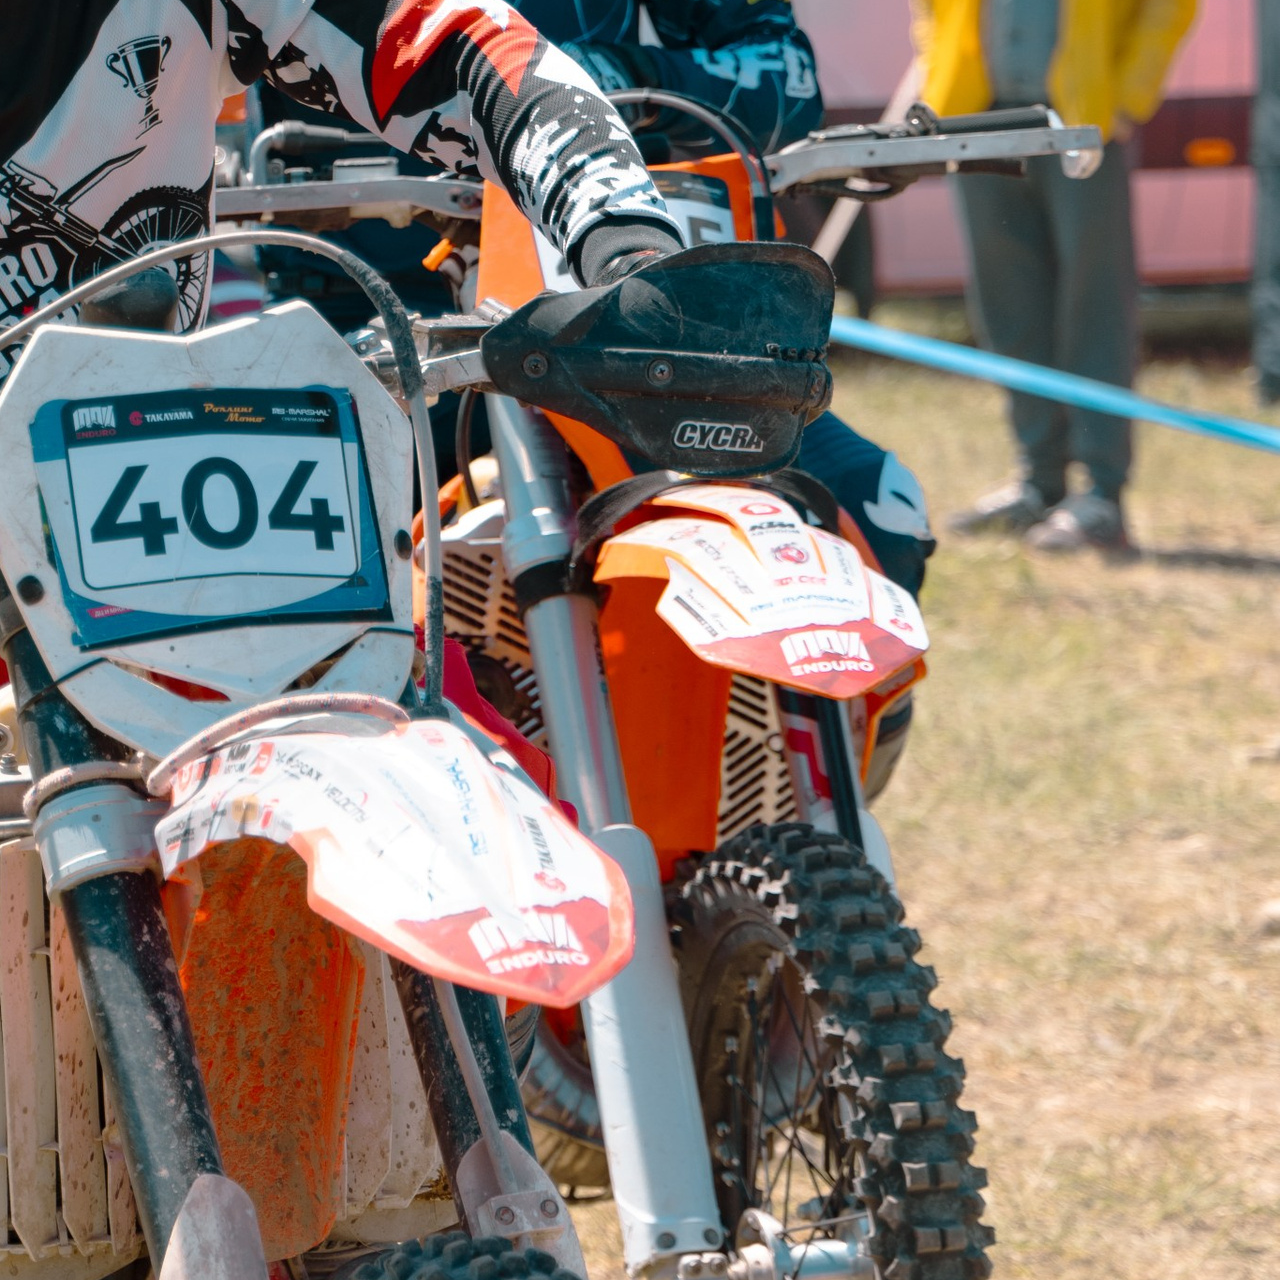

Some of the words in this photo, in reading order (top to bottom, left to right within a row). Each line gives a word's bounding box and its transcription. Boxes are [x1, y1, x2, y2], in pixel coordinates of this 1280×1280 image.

[144, 411, 194, 423] TAKAYAMA
[76, 428, 118, 440] ENDURO
[90, 455, 346, 558] 404
[789, 660, 875, 677] ENDURO
[485, 949, 590, 975] ENDURO
